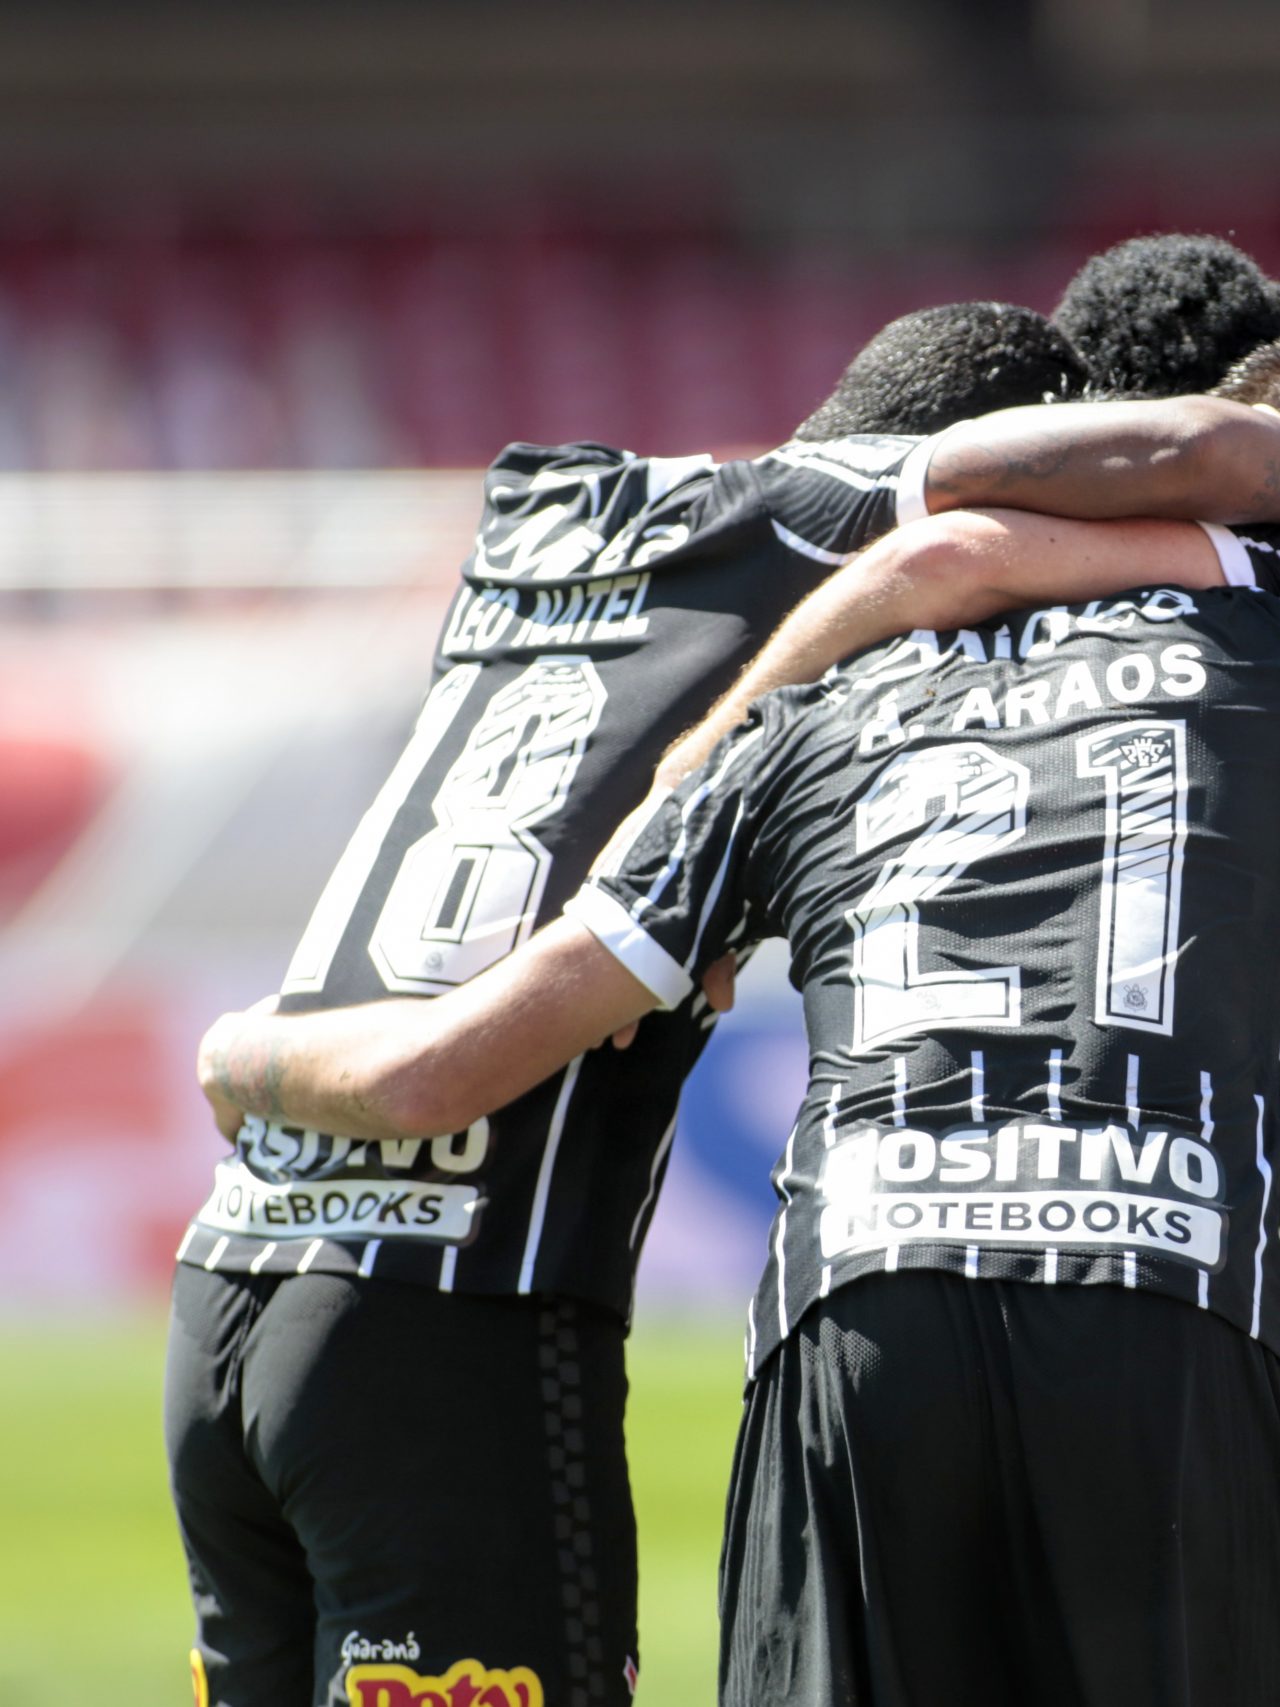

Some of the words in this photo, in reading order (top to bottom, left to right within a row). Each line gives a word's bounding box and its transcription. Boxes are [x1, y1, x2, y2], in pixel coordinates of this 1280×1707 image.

[511, 572, 651, 648] NATEL
[951, 643, 1208, 733] ARAOS
[279, 655, 609, 998] 18
[844, 717, 1189, 1056] 21
[846, 1201, 1193, 1245] NOTEBOOKS
[340, 1630, 421, 1667] Guaraná
